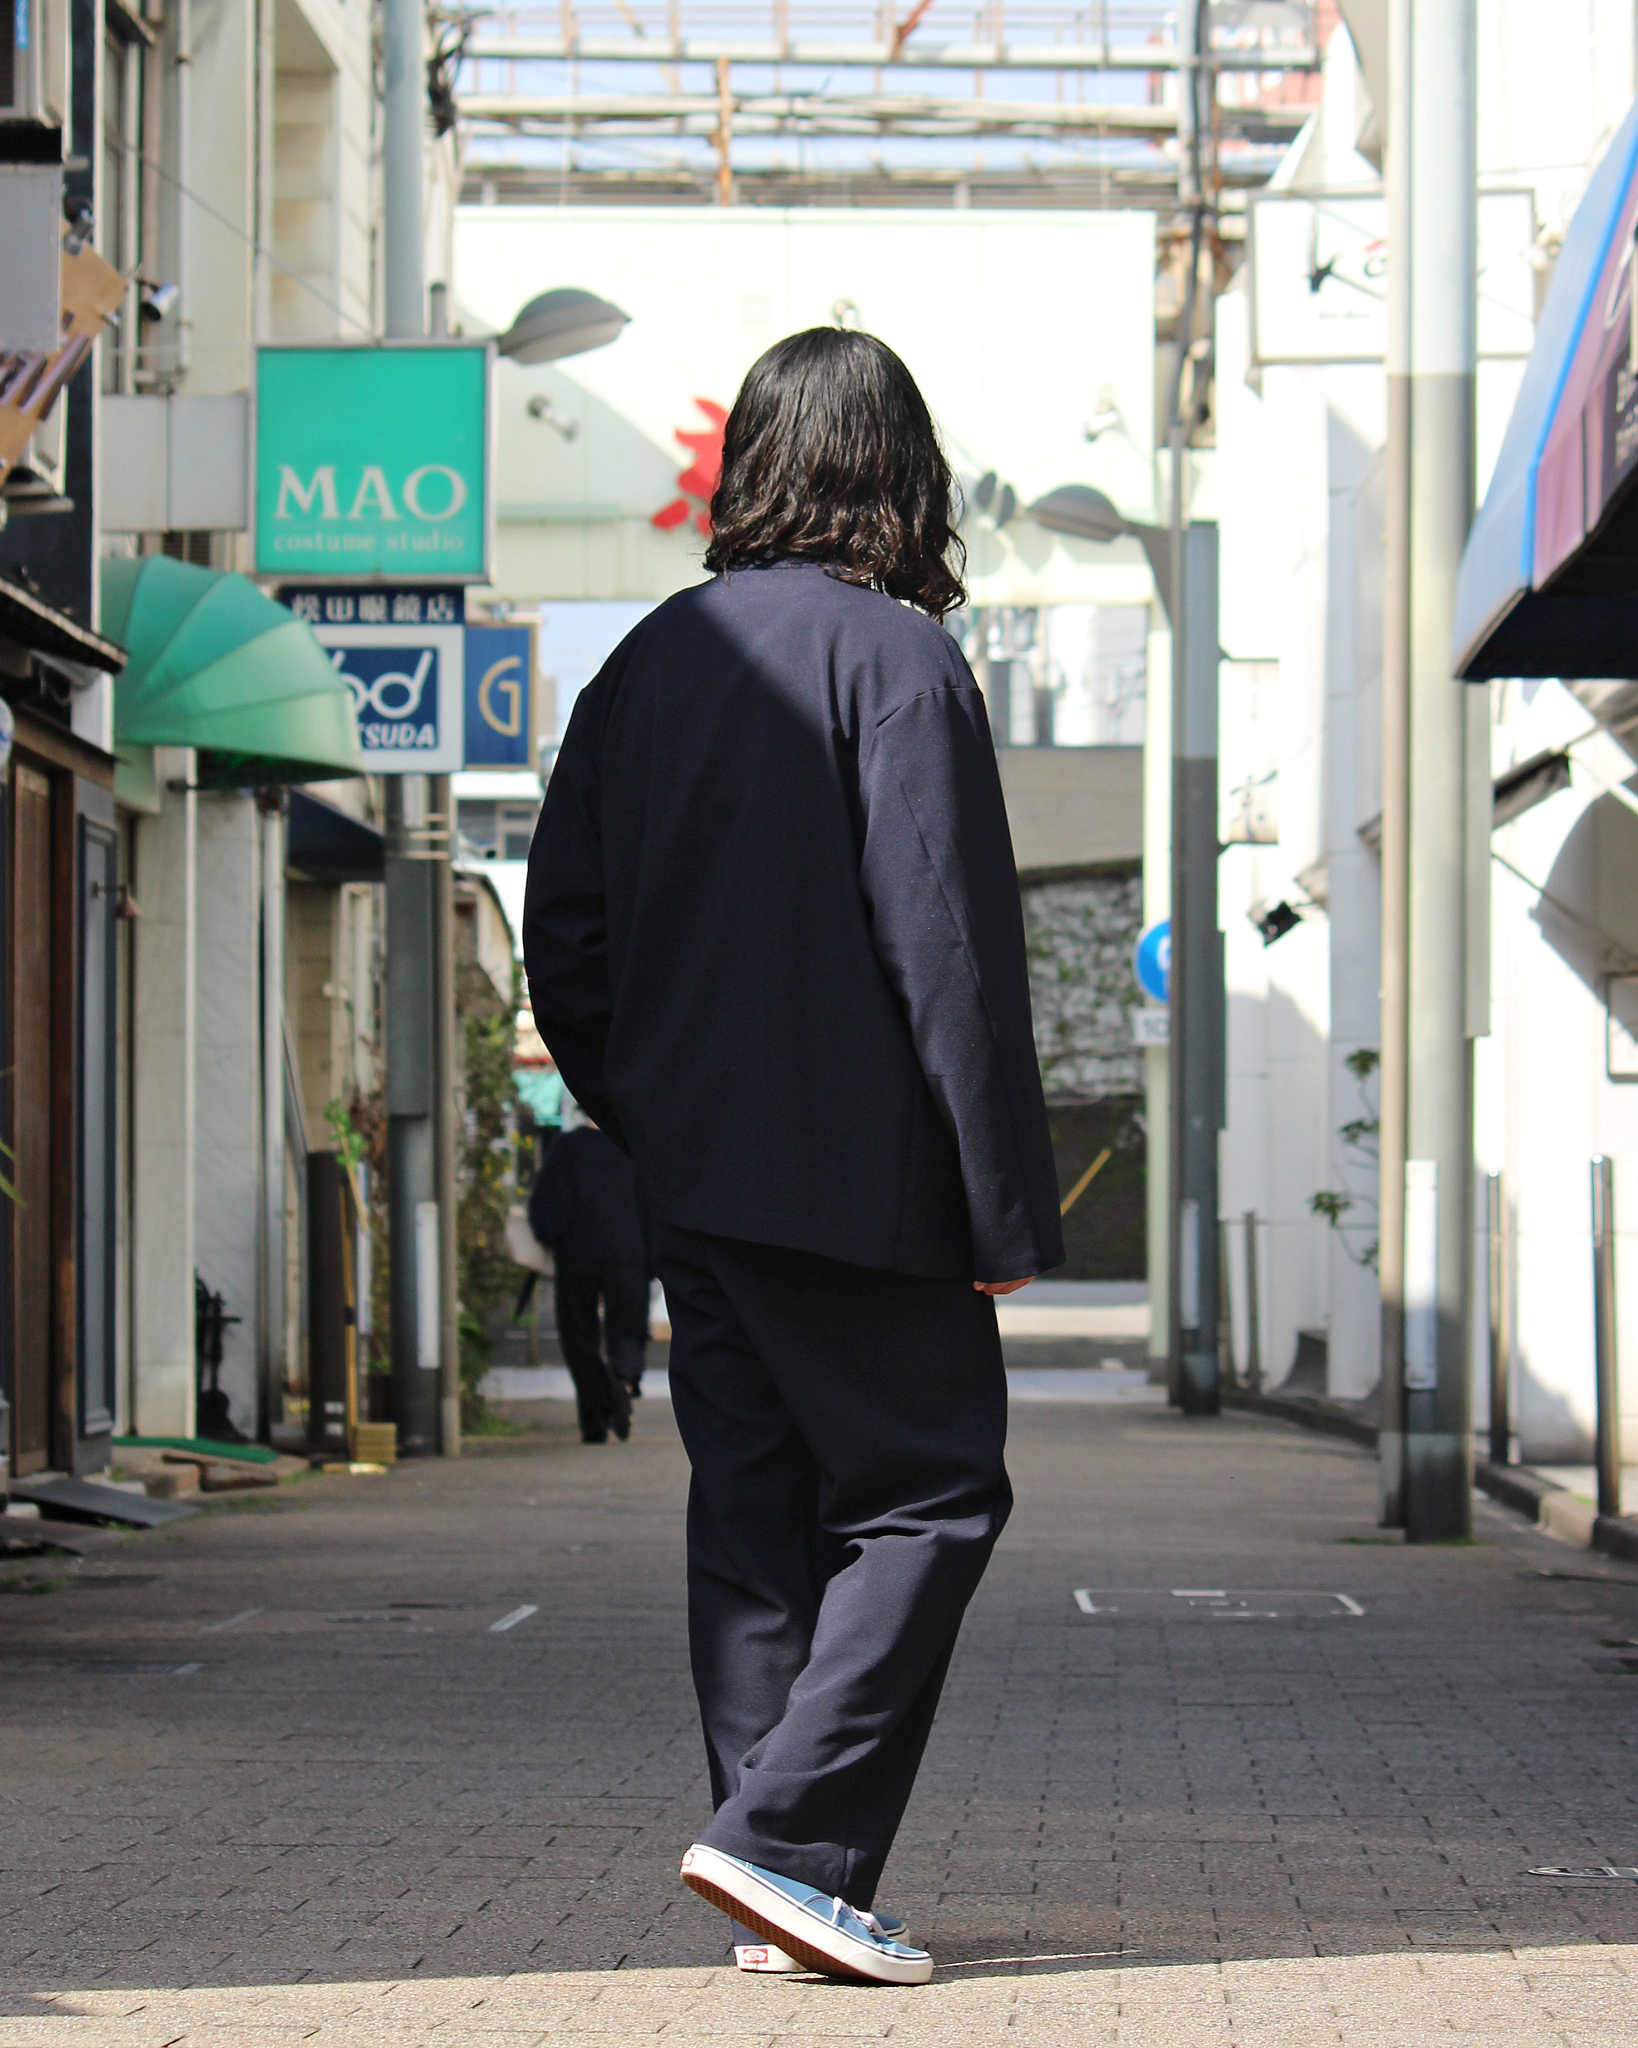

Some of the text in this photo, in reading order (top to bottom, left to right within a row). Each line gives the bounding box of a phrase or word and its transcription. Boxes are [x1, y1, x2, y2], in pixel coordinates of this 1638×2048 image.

[273, 464, 467, 522] MAO
[273, 527, 465, 552] costume studio
[478, 656, 520, 736] G
